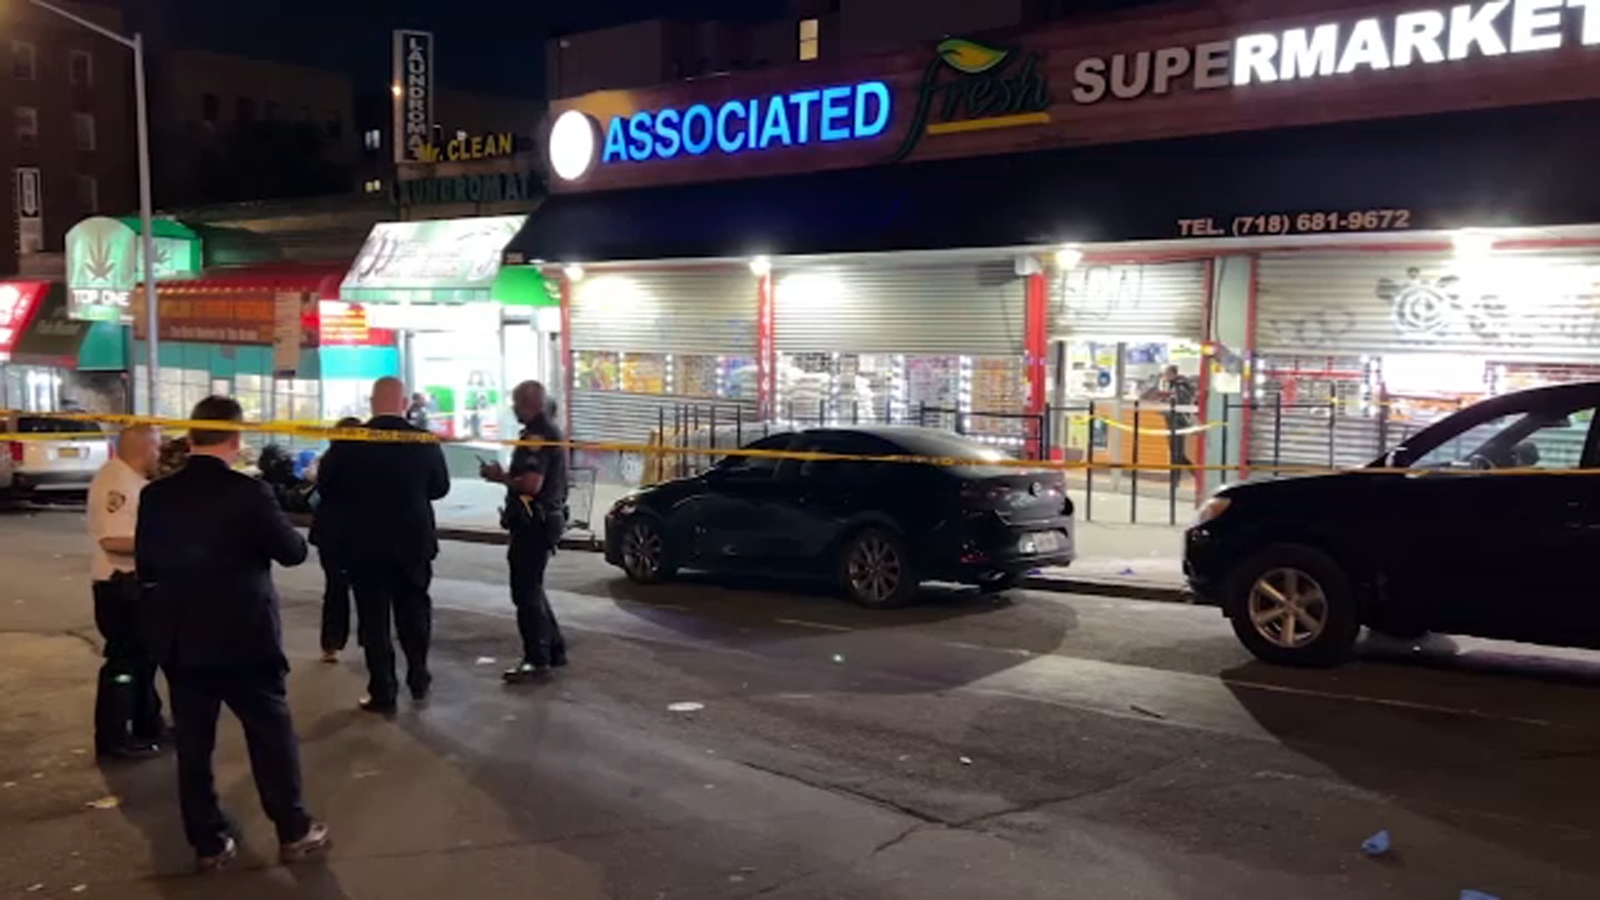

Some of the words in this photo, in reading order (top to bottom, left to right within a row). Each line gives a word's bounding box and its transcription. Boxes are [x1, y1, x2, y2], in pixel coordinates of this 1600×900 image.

[1071, 0, 1600, 104] SUPERMARKET
[603, 80, 892, 163] ASSOCIATED
[447, 132, 512, 161] CLEAN
[1178, 219, 1224, 236] TEL.
[1232, 215, 1289, 236] (718)
[1296, 209, 1411, 232] 681-9672
[73, 289, 98, 305] TOP
